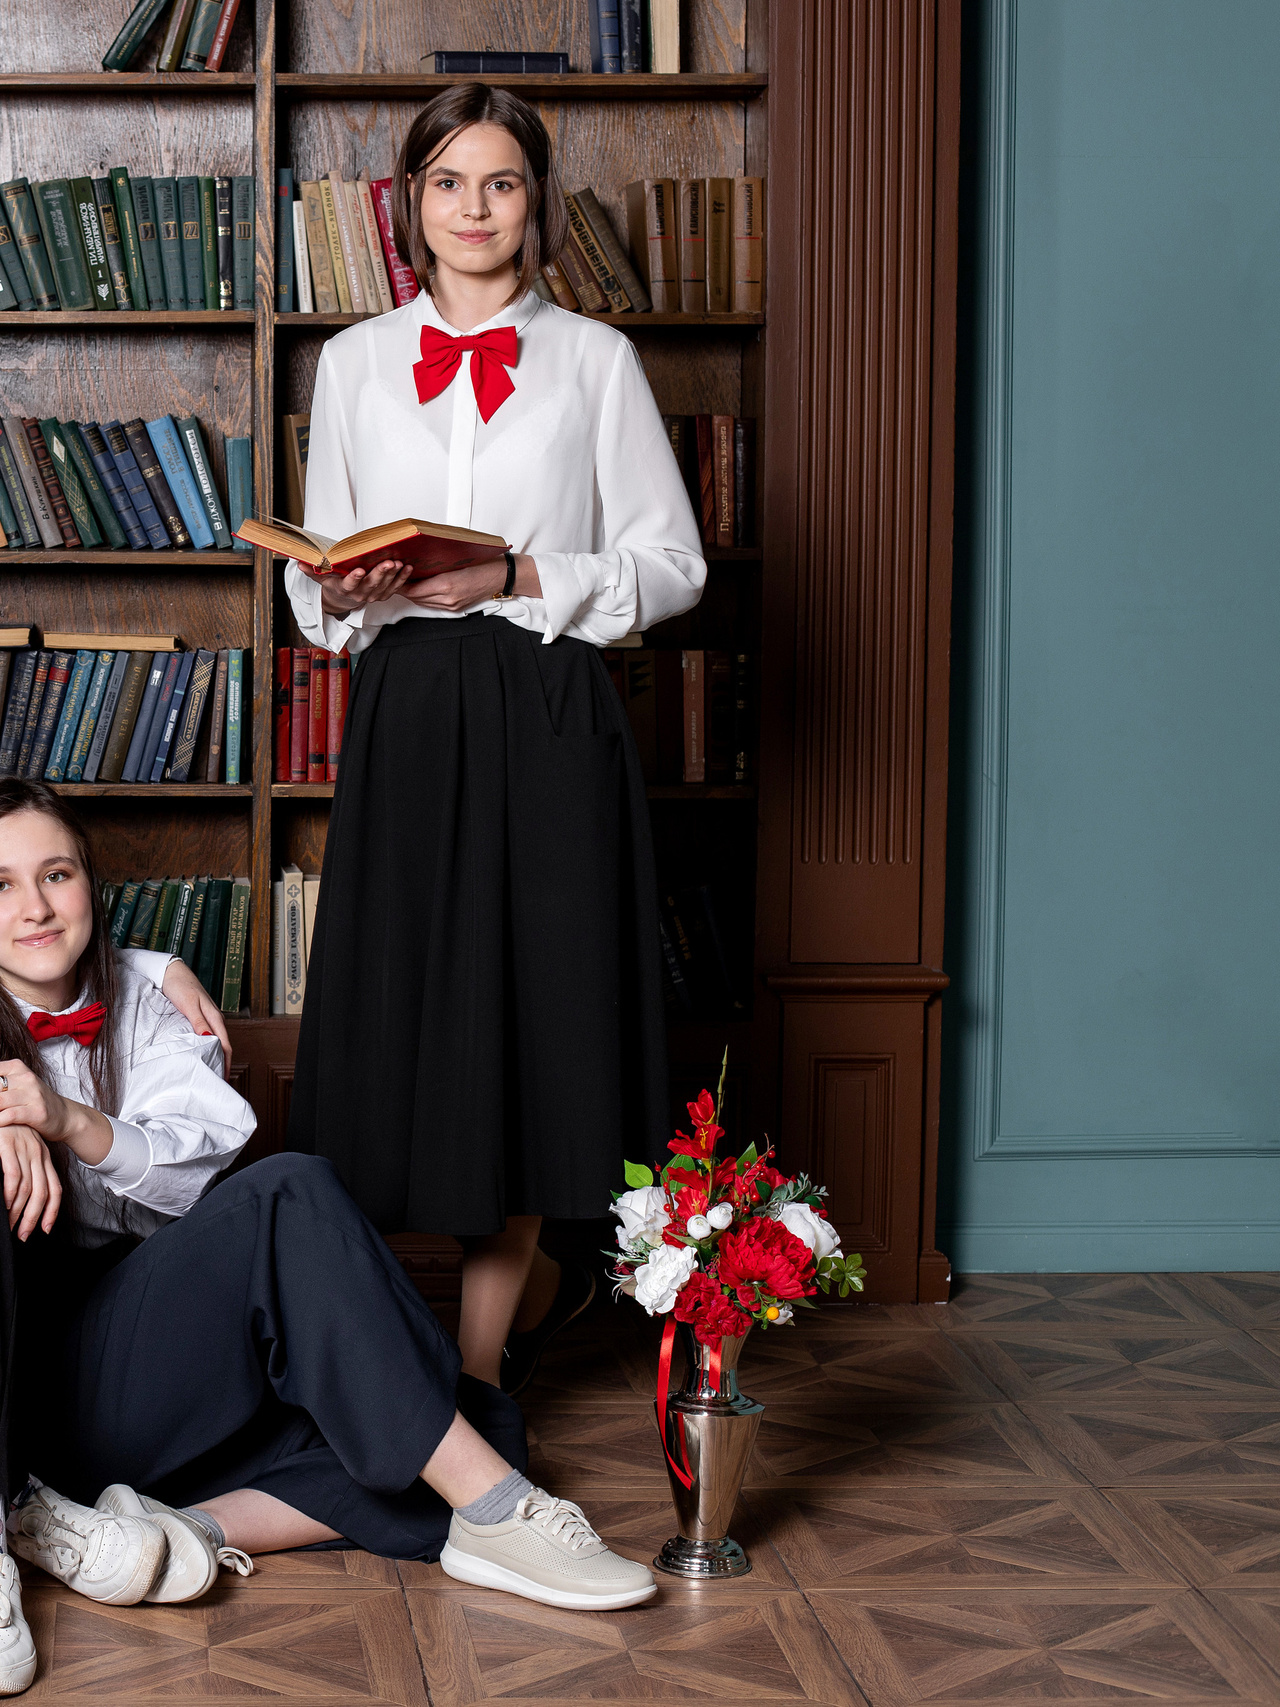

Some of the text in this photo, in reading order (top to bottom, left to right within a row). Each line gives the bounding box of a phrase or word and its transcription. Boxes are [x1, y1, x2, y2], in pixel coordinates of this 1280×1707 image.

[204, 192, 212, 227] ШОЛОХОВ
[325, 186, 342, 261] УГОЛЕК ЯШОНОК
[186, 224, 198, 237] 22
[565, 196, 620, 294] СТЕНДАЛЬ
[97, 270, 103, 279] 1
[348, 256, 354, 265] OF
[349, 266, 359, 299] GRAMMAR
[162, 444, 178, 475] ГОЛОСА
[164, 429, 184, 468] ТИШИНЕ
[90, 480, 99, 491] БЕЗ
[187, 430, 221, 522] ДЖОН ГОЛСУОРСИ
[189, 508, 202, 529] ВИКТОР
[720, 487, 729, 531] Проклятие
[161, 658, 178, 702] Борис Полевой
[119, 666, 142, 740] ЛЕВ ТОЛСТОЙ
[189, 894, 204, 943] СТЕНДАЛЬ
[231, 907, 239, 930] ЯГУАР
[237, 895, 245, 930] АРАВАКОВ
